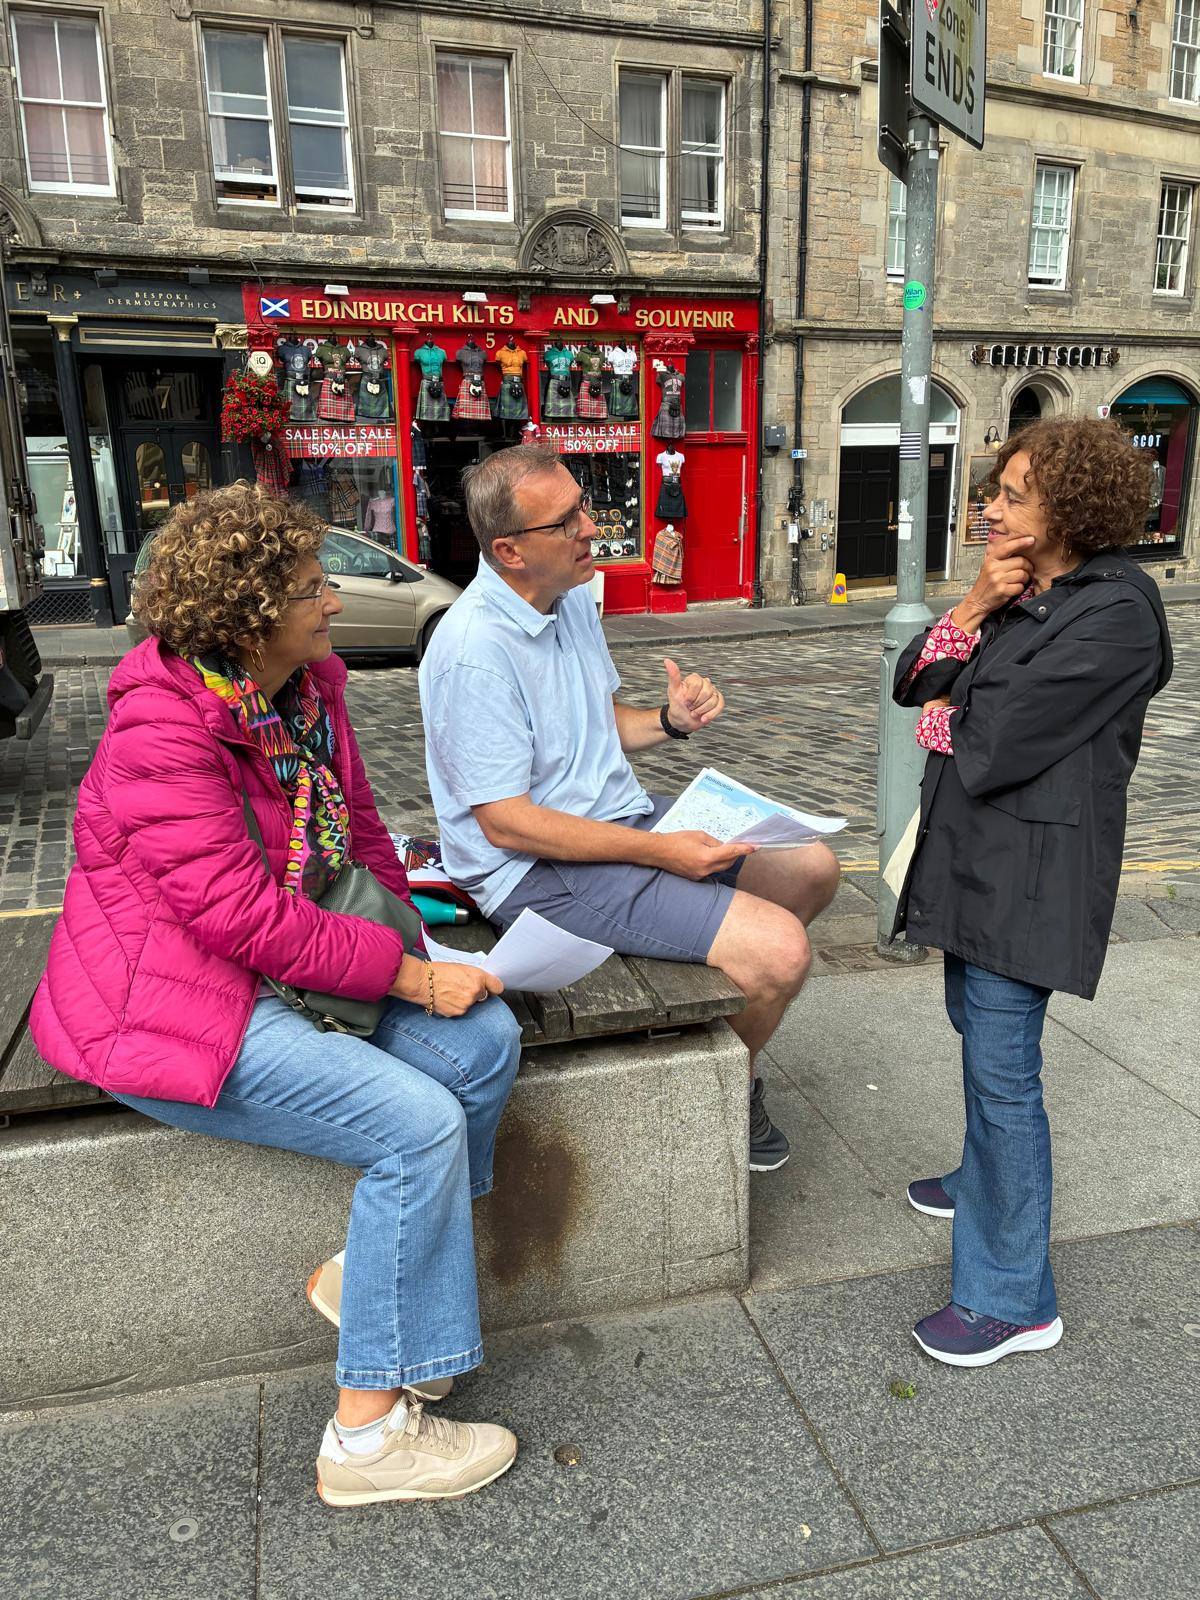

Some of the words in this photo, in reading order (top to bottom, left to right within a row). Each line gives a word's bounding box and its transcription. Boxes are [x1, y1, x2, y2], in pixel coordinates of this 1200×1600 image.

[939, 0, 966, 43] Zone
[925, 30, 975, 115] ENDS
[135, 291, 190, 301] BESPOKE
[107, 298, 217, 309] DERMOGRAPHICS
[301, 299, 443, 323] EDINBURGH
[452, 303, 514, 325] KILTS
[553, 307, 599, 326] AND
[635, 309, 735, 328] SOUVENIR
[485, 332, 496, 349] 5
[990, 345, 1051, 367] GREAT
[1056, 346, 1103, 368] SCOT
[156, 386, 171, 409] 7
[285, 430, 320, 440] SALE
[323, 429, 357, 440] SALE
[360, 428, 392, 440] SALE
[546, 427, 575, 437] SALE
[577, 426, 606, 437] SALE
[609, 426, 637, 436] SALE
[567, 440, 592, 451] 50%
[596, 439, 619, 451] OFF
[1133, 434, 1162, 448] SCOT
[311, 443, 341, 455] 50%
[345, 442, 373, 455] OFF
